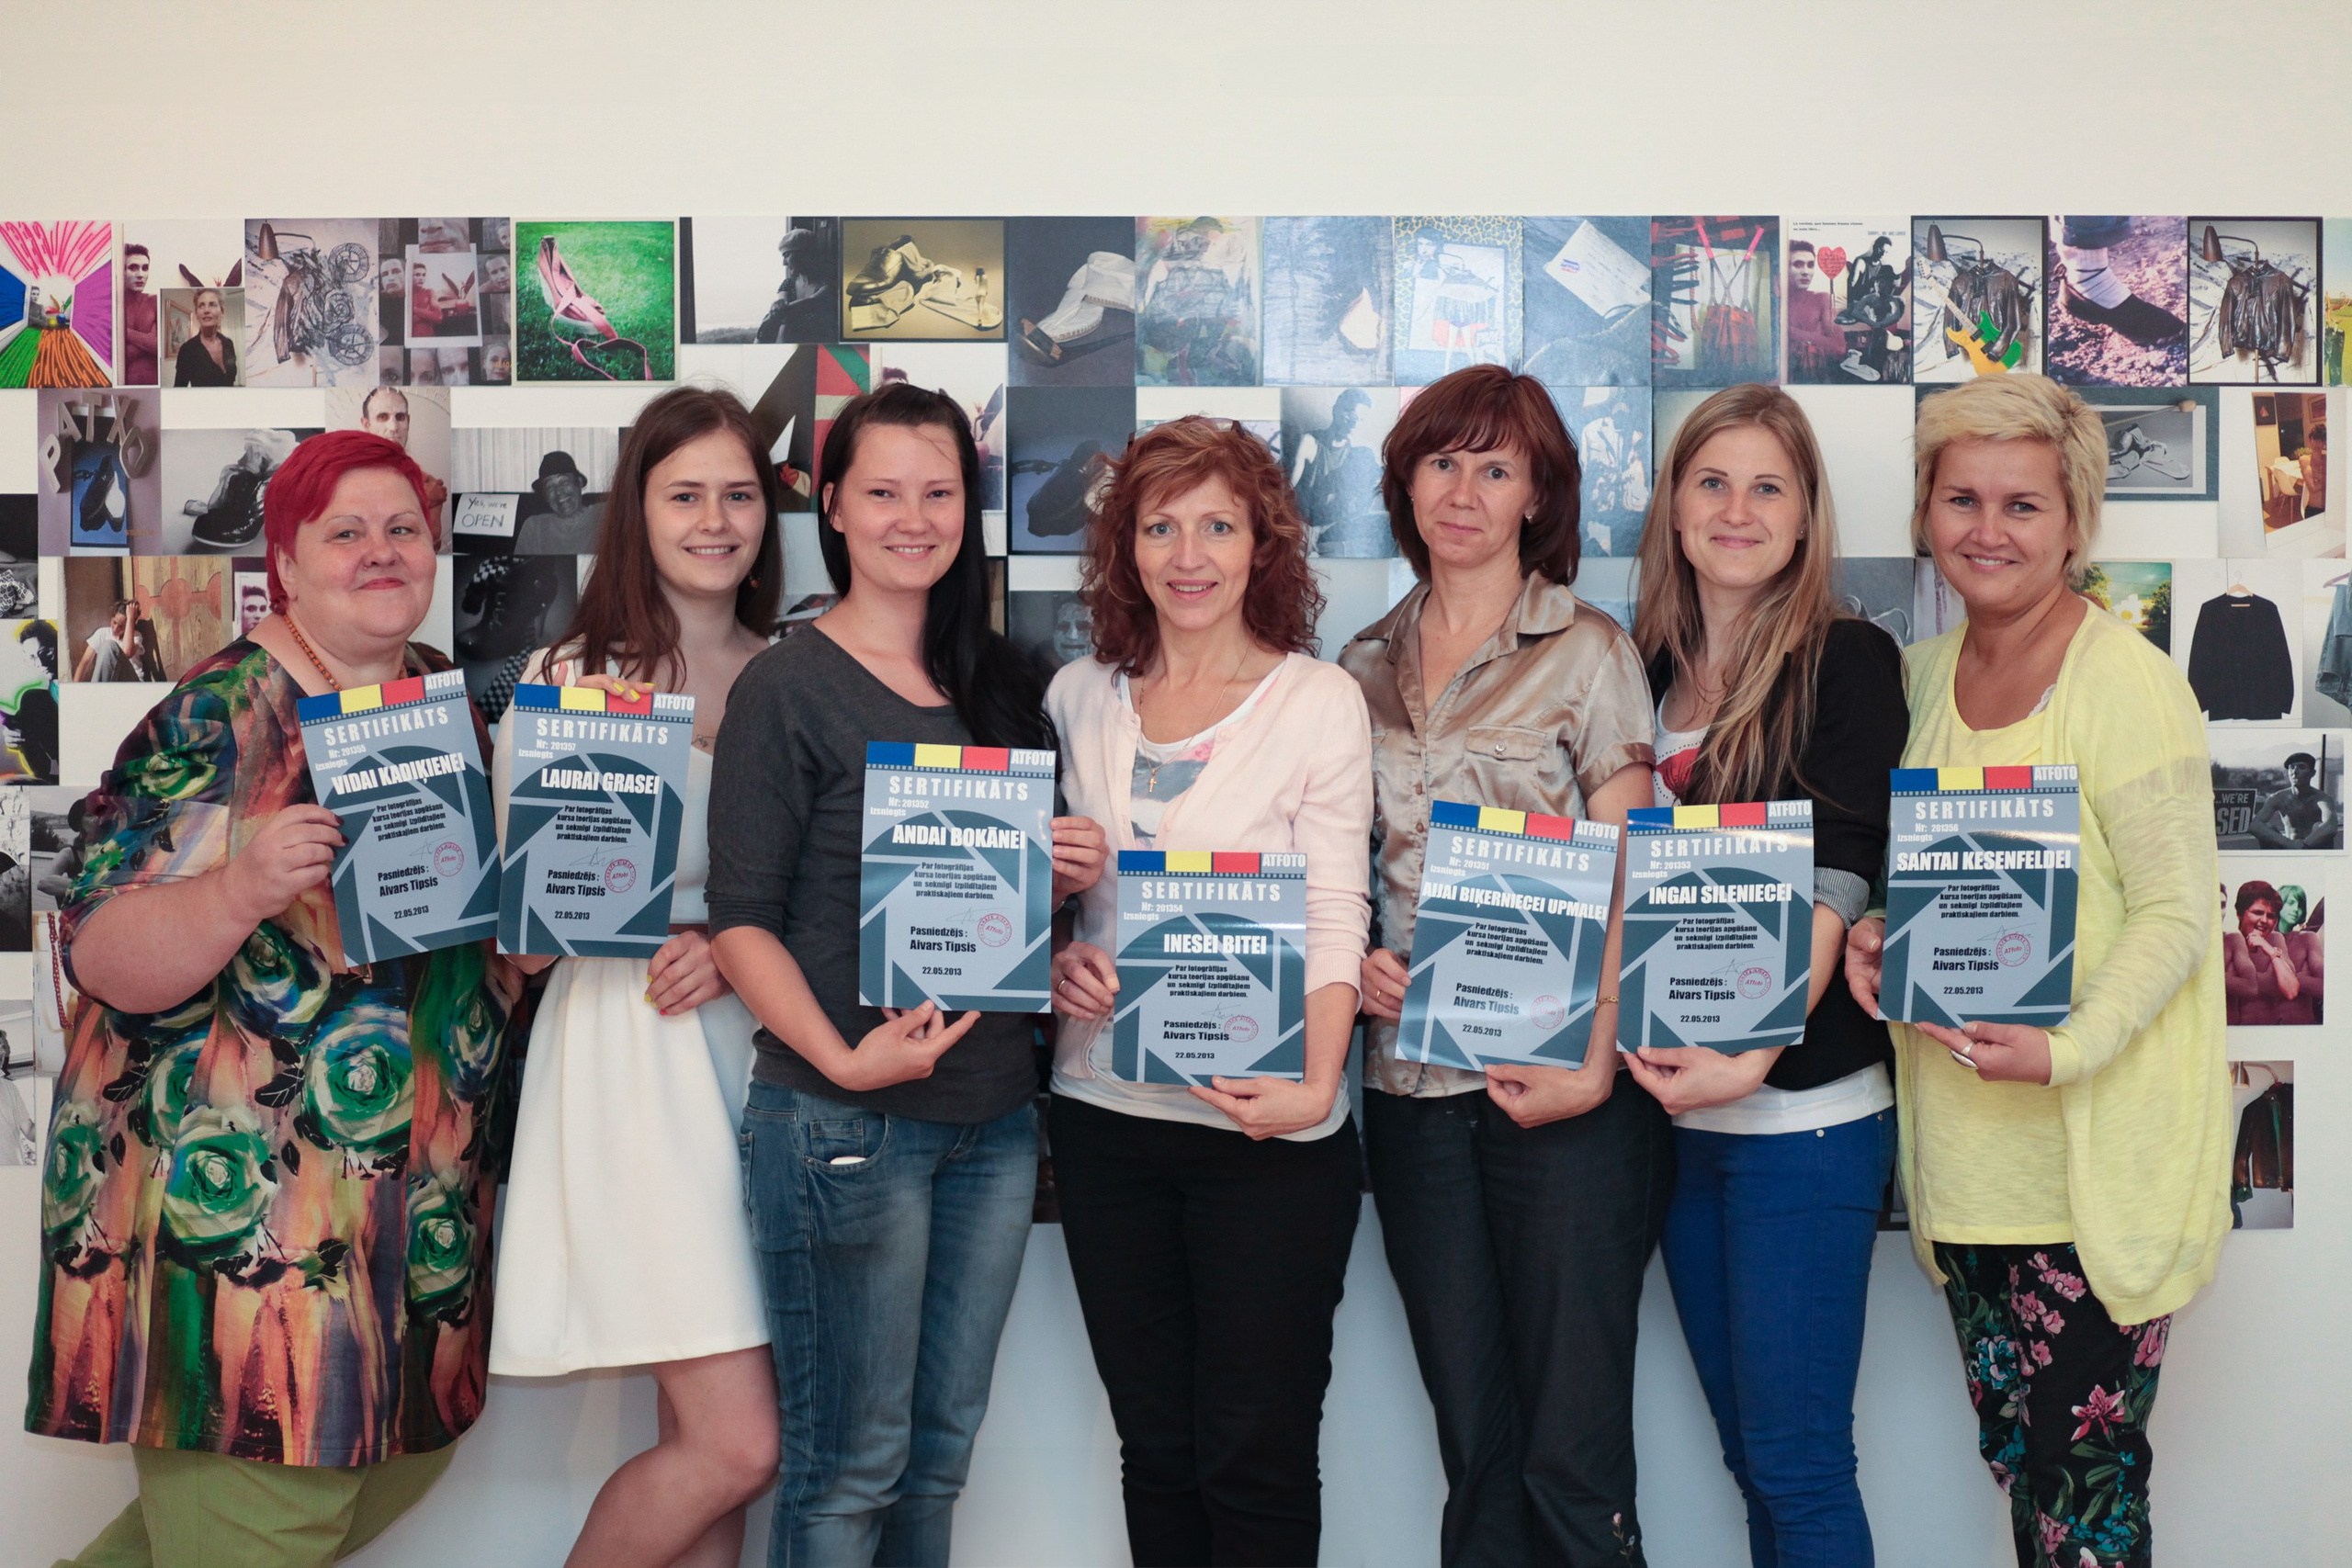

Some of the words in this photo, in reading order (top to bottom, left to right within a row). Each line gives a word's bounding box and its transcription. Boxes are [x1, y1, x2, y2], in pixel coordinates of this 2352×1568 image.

[462, 513, 504, 528] OPEN
[425, 670, 464, 691] ATFOTO
[654, 694, 694, 711] ATFOTO
[325, 705, 448, 746] SERTIFIKĀTS
[537, 718, 668, 745] SERTIFIKĀTS
[1012, 751, 1055, 766] ATFOTO
[331, 768, 378, 795] VIDAI
[540, 767, 599, 790] LAURAI
[601, 772, 660, 794] GRASEI
[2034, 766, 2077, 781] ATFOTO
[889, 776, 1028, 801] SERTIFIKĀTS
[376, 804, 387, 812] Par
[1769, 801, 1812, 817] ATFOTO
[1917, 797, 2053, 819] SERTIFIKĀTS
[372, 813, 390, 822] kursa
[575, 815, 600, 823] teorijas
[892, 824, 945, 845] ANDAI
[950, 825, 1025, 849] BOKĀNEI
[1575, 821, 1618, 840] ATFOTO
[1262, 854, 1306, 867] ATFOTO
[1452, 836, 1589, 871] SERTIFIKĀTS
[1896, 852, 1958, 871] SANTAI
[1962, 850, 2071, 870] KESENFELDEI
[935, 872, 961, 880] teorijas
[378, 880, 409, 897] Aivars
[409, 874, 438, 892] Tipsis
[545, 883, 576, 895] Aivars
[577, 885, 605, 897] Tipsis
[1142, 882, 1280, 901] SERTIFIKĀTS
[1648, 886, 1697, 904] INGAI
[1700, 883, 1792, 903] SILENIECEI
[1422, 881, 1457, 900] AIJAI
[1547, 898, 1607, 920] UPMALEI
[393, 904, 429, 919] 22.05.2013
[554, 910, 590, 919] 22.05.2013
[1466, 930, 1486, 938] kursa
[910, 939, 943, 951] Aivars
[944, 941, 976, 953] Tipsis
[1164, 933, 1218, 953] INESEI
[1221, 934, 1268, 954] BITEI
[922, 966, 961, 976] 22.05.2013
[1932, 960, 1965, 971] Aivars
[1967, 960, 1998, 971] Tipsis
[1668, 989, 1702, 999] Aivars
[1703, 989, 1735, 1000] Tipsis
[1453, 995, 1487, 1010] Aivars
[1487, 1000, 1520, 1015] Tipsis
[1163, 1031, 1195, 1040] Aivars
[1198, 1032, 1228, 1041] Tipsis
[1462, 1024, 1501, 1036] 22.05.2013
